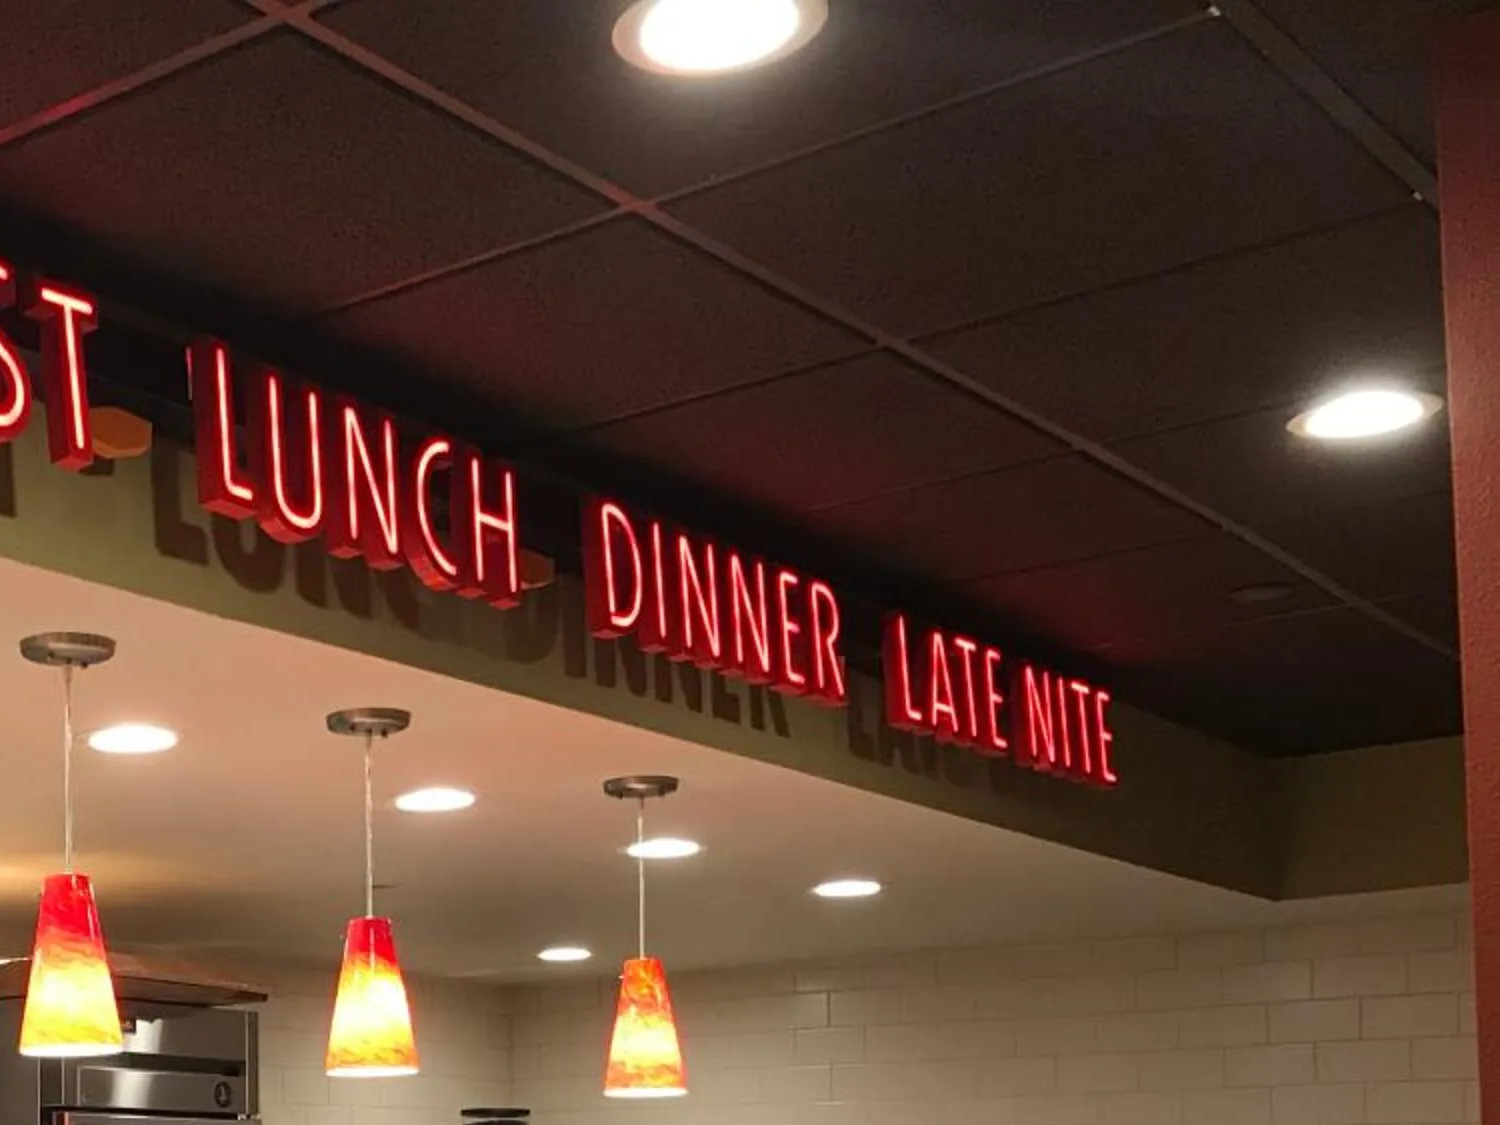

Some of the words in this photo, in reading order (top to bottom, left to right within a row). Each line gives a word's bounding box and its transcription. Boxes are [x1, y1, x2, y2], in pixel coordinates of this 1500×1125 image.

[198, 342, 522, 606] LUNCH
[585, 498, 847, 702] DINNER
[886, 612, 1010, 752] LATE
[1016, 660, 1118, 786] NITE
